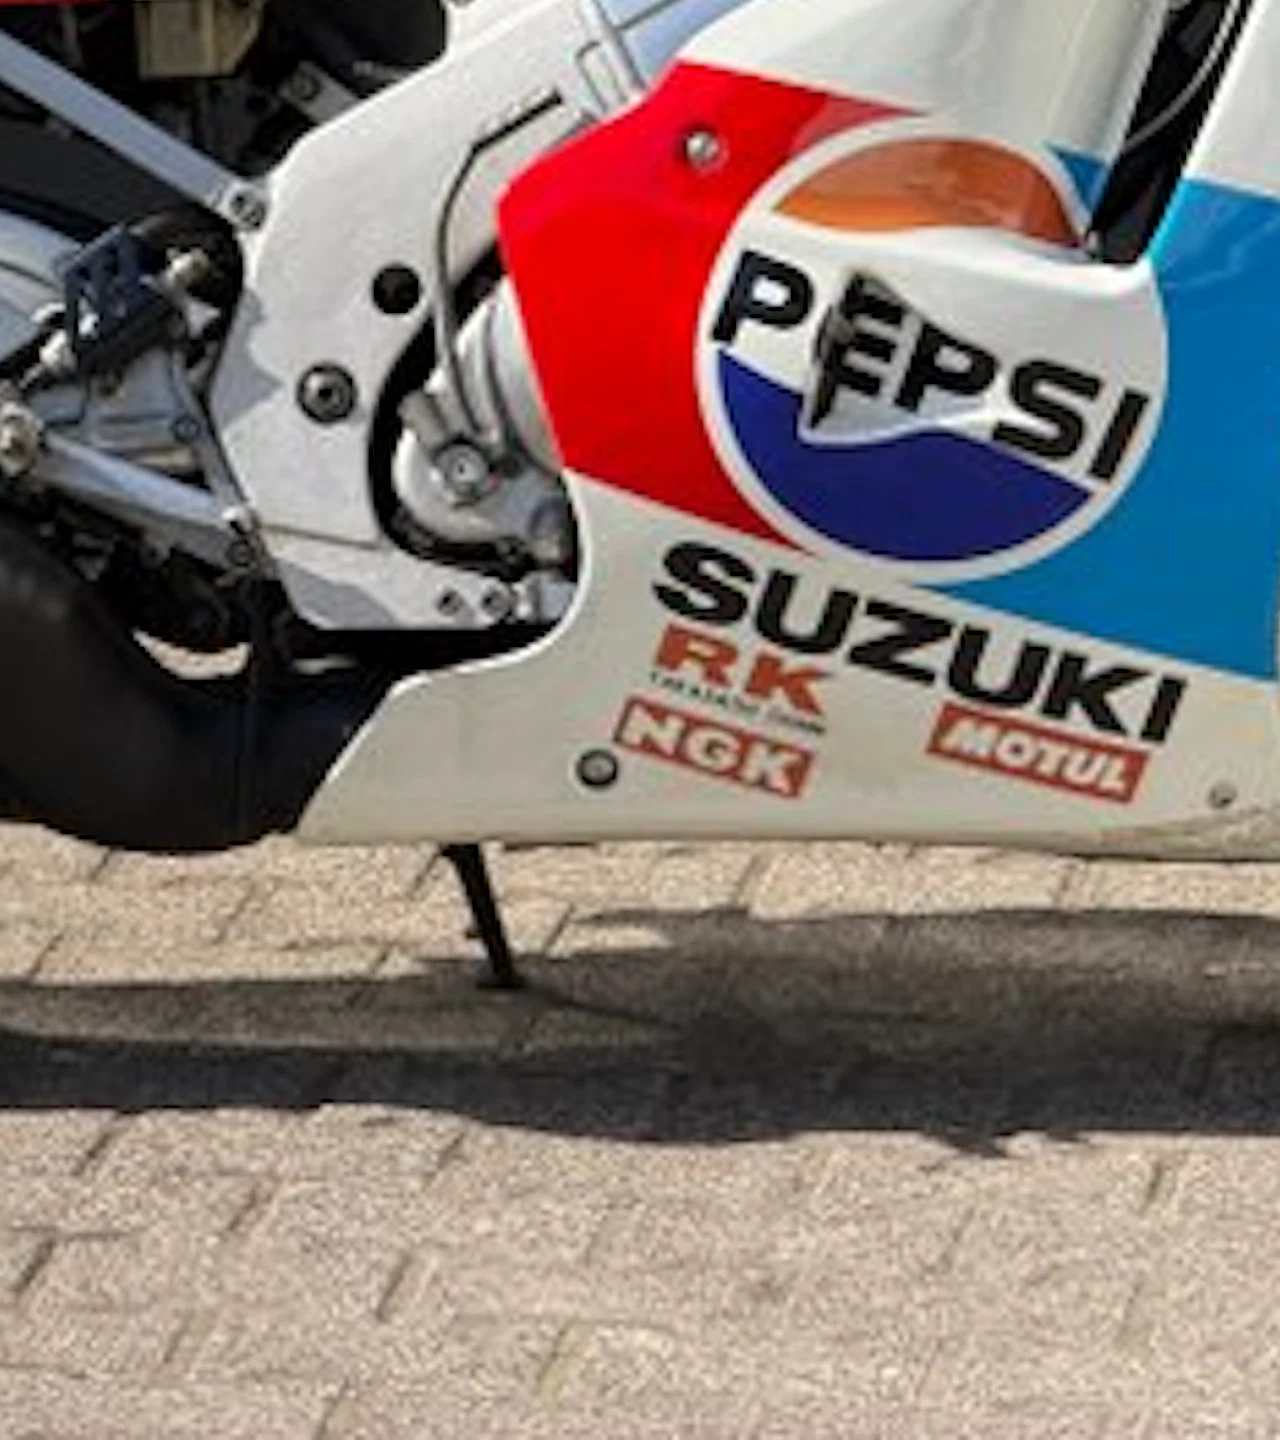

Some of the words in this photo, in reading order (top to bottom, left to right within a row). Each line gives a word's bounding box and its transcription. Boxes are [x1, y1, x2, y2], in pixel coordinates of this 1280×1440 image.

[711, 250, 1150, 483] PEPSI
[653, 541, 1188, 743] SUZUKI
[656, 624, 834, 715] RK
[622, 704, 810, 793] NGK
[937, 717, 1127, 793] MOTUL
